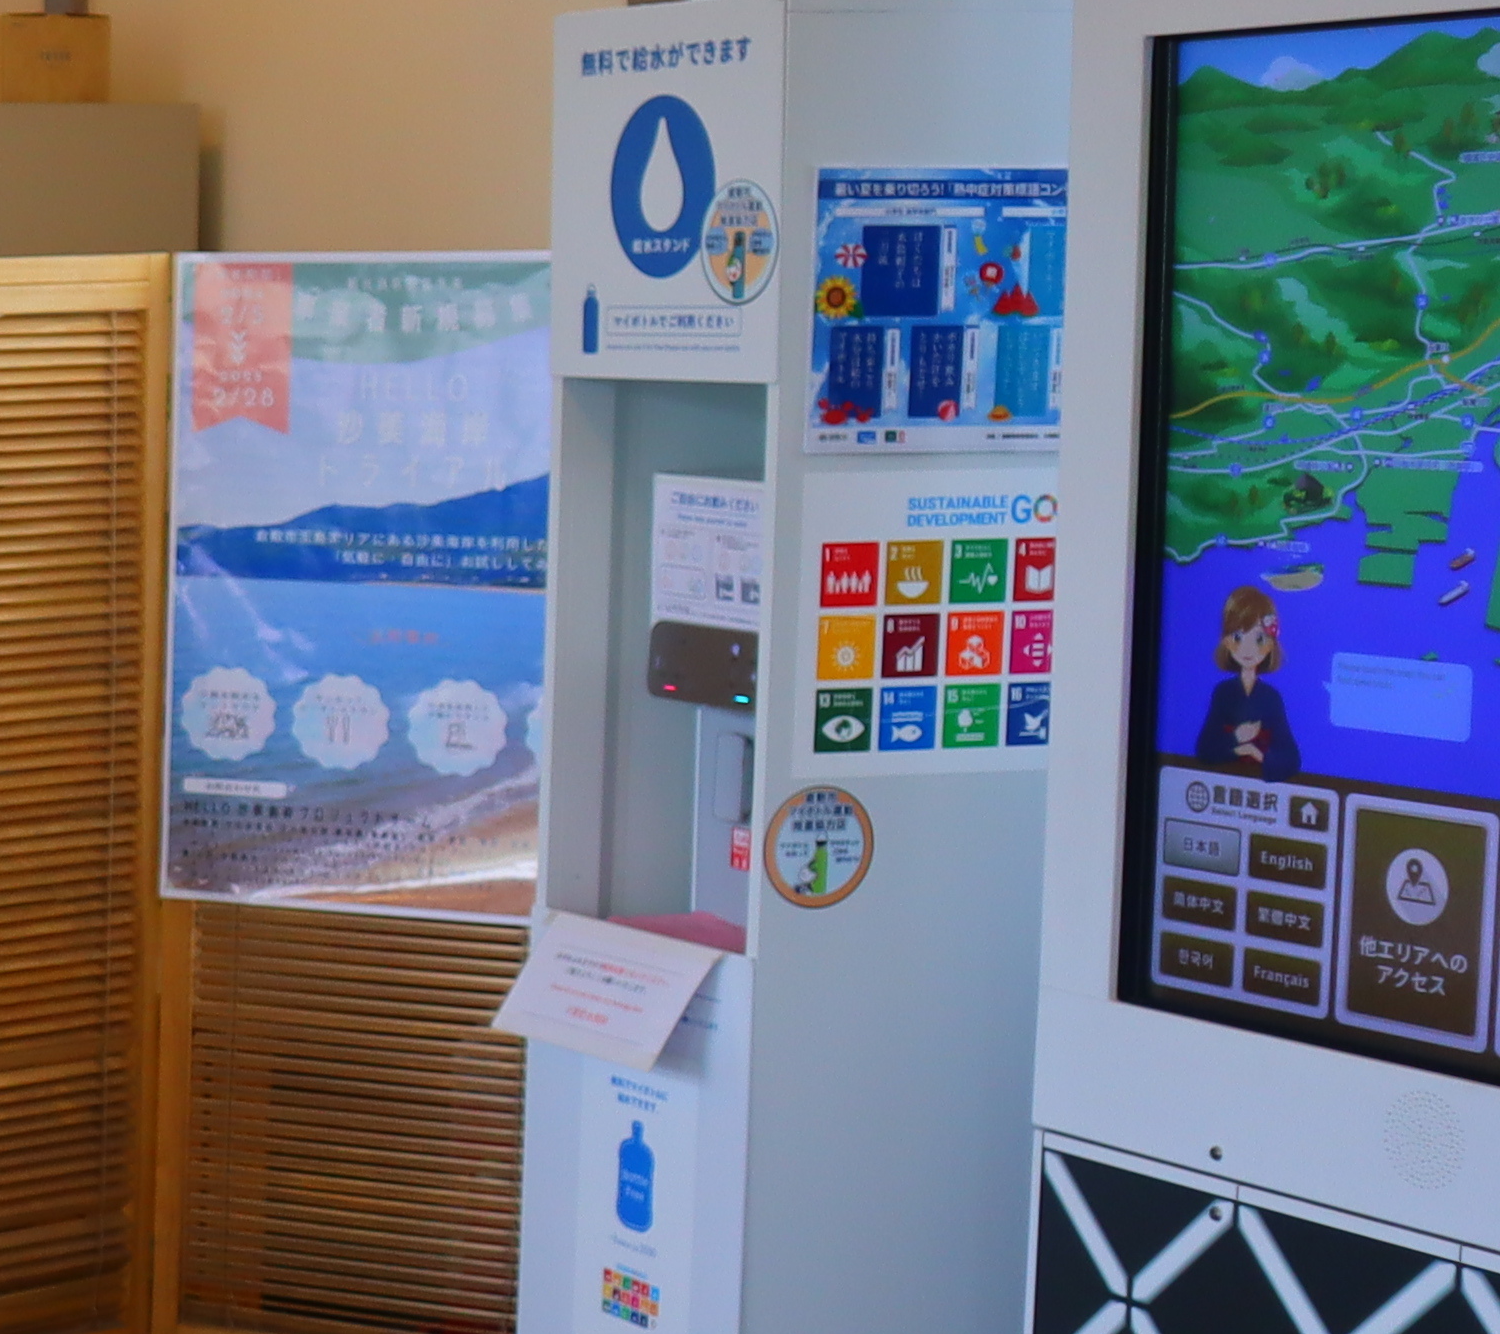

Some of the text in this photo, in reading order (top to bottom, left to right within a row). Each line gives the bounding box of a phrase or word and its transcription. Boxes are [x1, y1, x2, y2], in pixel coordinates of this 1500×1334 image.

[582, 37, 751, 77] 無料で給水ができます
[632, 237, 692, 255] 給水スタンド
[213, 388, 275, 408] 2/28
[360, 373, 469, 402] HELLO
[908, 495, 1008, 511] SUSTAINABLE
[907, 512, 1007, 528] DEVELOPMENT
[1183, 836, 1220, 857] 日本語
[1260, 850, 1314, 872] English
[1178, 948, 1214, 970] 한국어
[1360, 935, 1468, 974] 他エリアへの
[1253, 965, 1311, 989] Français
[1377, 964, 1446, 996] アクセス
